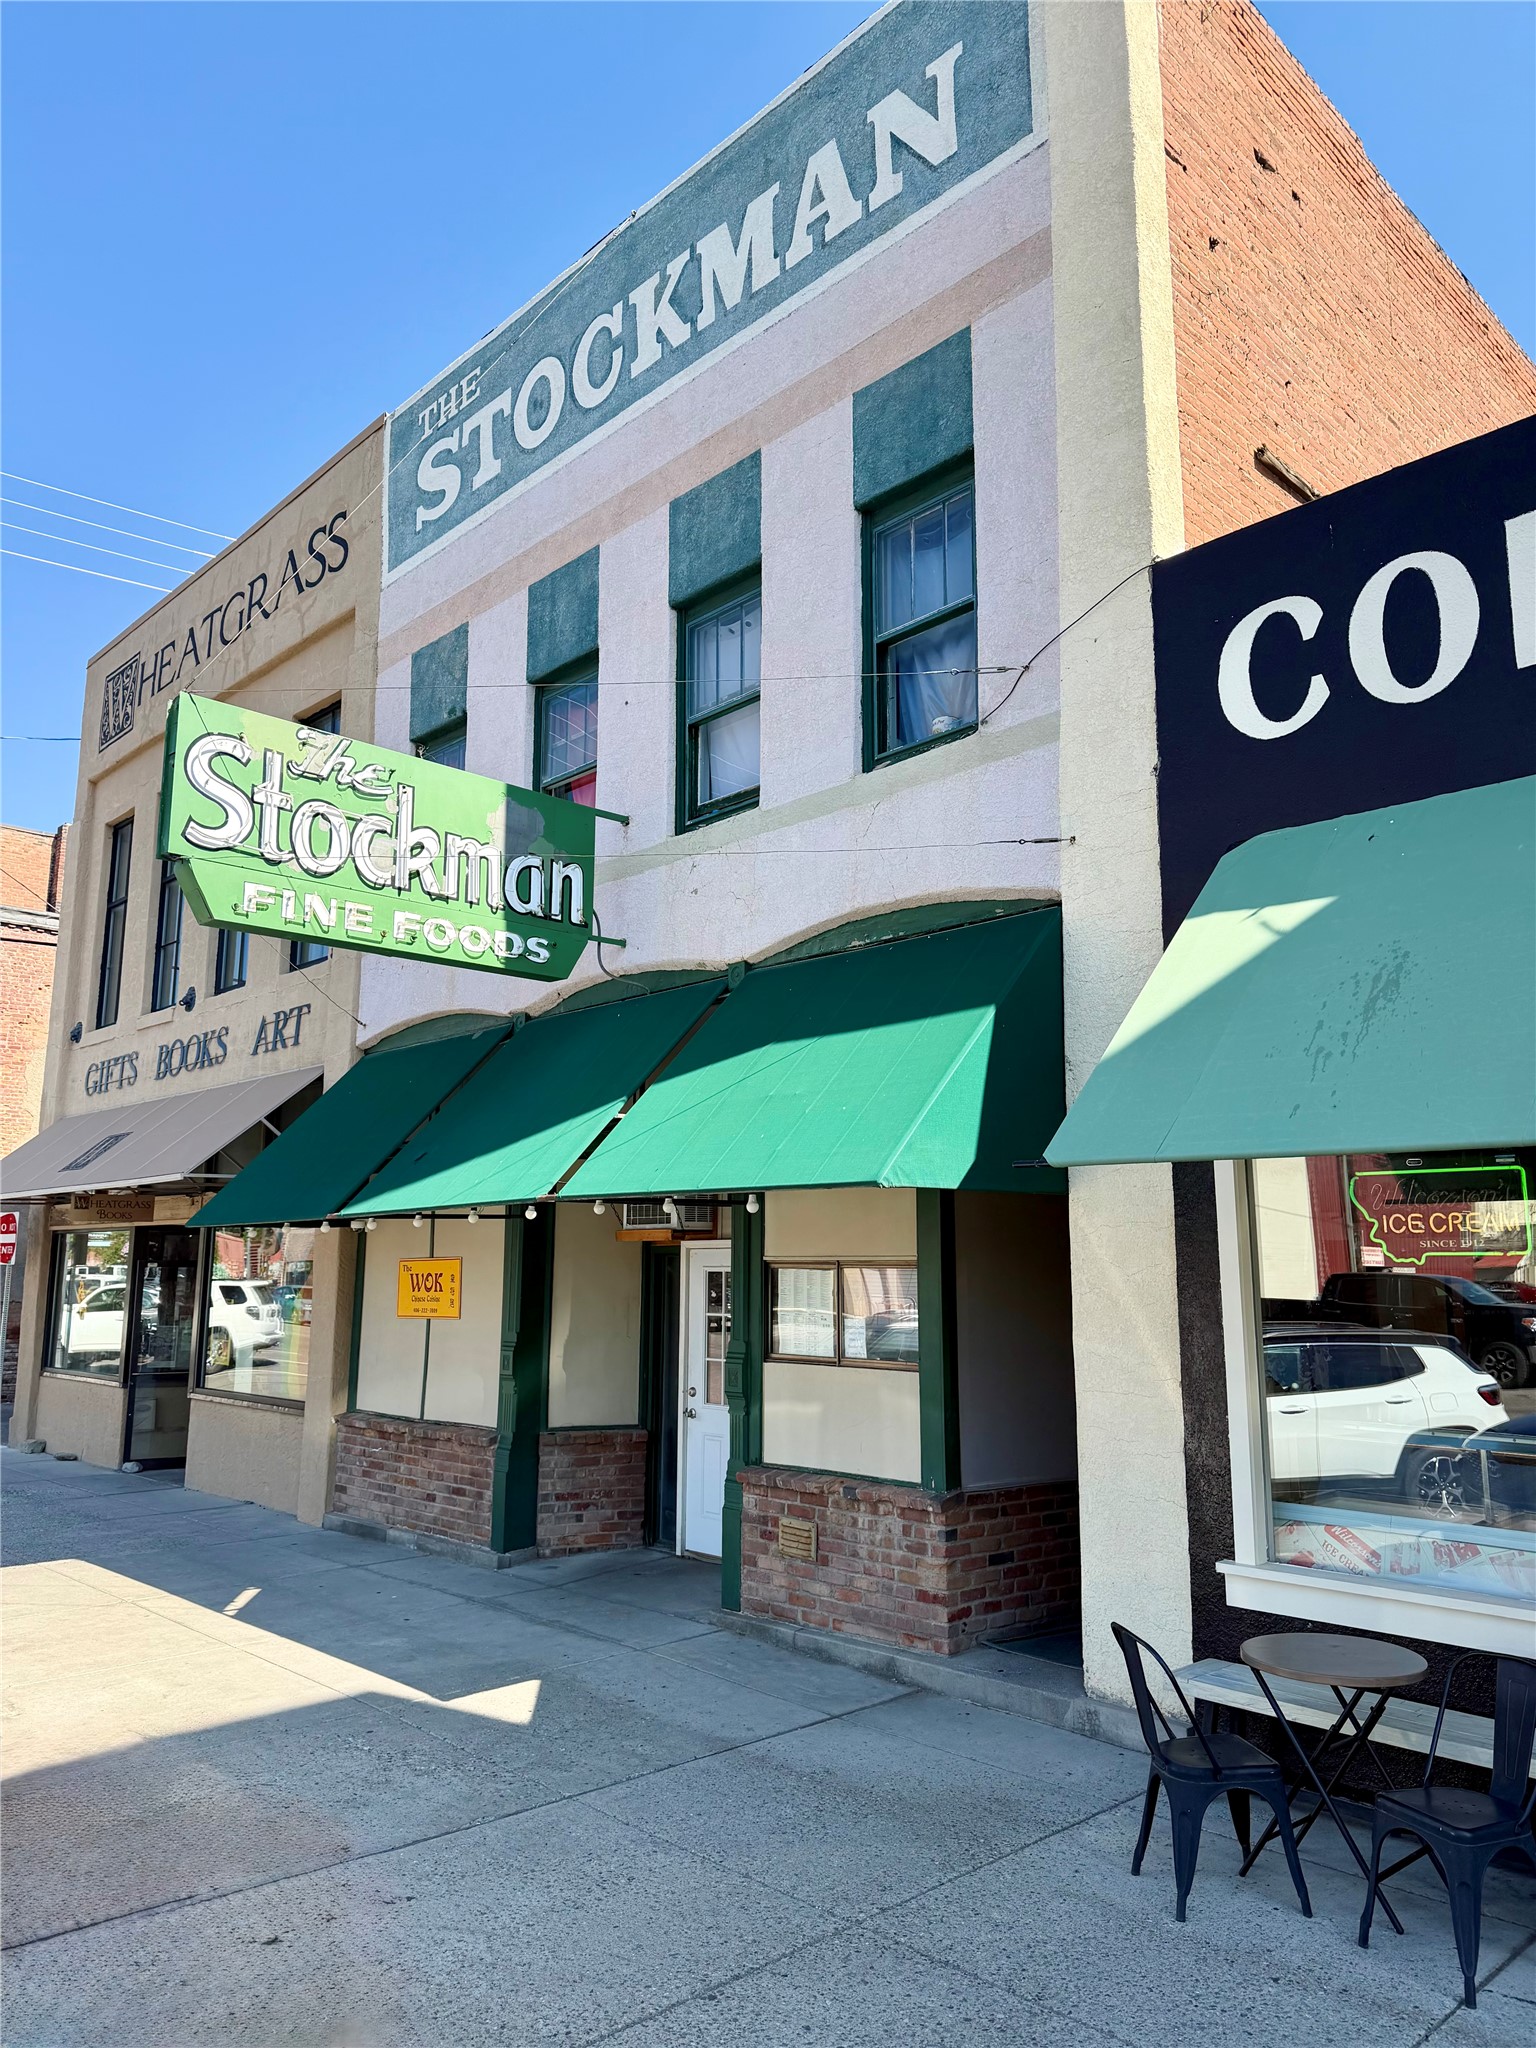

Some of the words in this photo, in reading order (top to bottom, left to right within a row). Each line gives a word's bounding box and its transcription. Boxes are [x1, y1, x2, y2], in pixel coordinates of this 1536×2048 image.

[415, 40, 963, 532] STOCKMAN
[417, 366, 481, 442] THE
[287, 726, 395, 801] The
[181, 732, 588, 929] Stockman
[242, 880, 375, 935] FINE
[393, 909, 551, 964] FOODS
[85, 1051, 139, 1097] GIFTS
[154, 1026, 229, 1081] BOOKS
[251, 1003, 311, 1056] ART
[74, 1195, 151, 1210] WHEATGRASS
[97, 1209, 133, 1220] BOOKS
[1382, 1212, 1426, 1234] ICE
[1429, 1212, 1521, 1233] CREAM
[1419, 1239, 1457, 1248] SINCE
[1460, 1239, 1485, 1248] 1912
[402, 1264, 413, 1273] The
[409, 1272, 444, 1293] WOK
[1322, 1539, 1339, 1558] ICE
[1339, 1554, 1370, 1577] CREA
